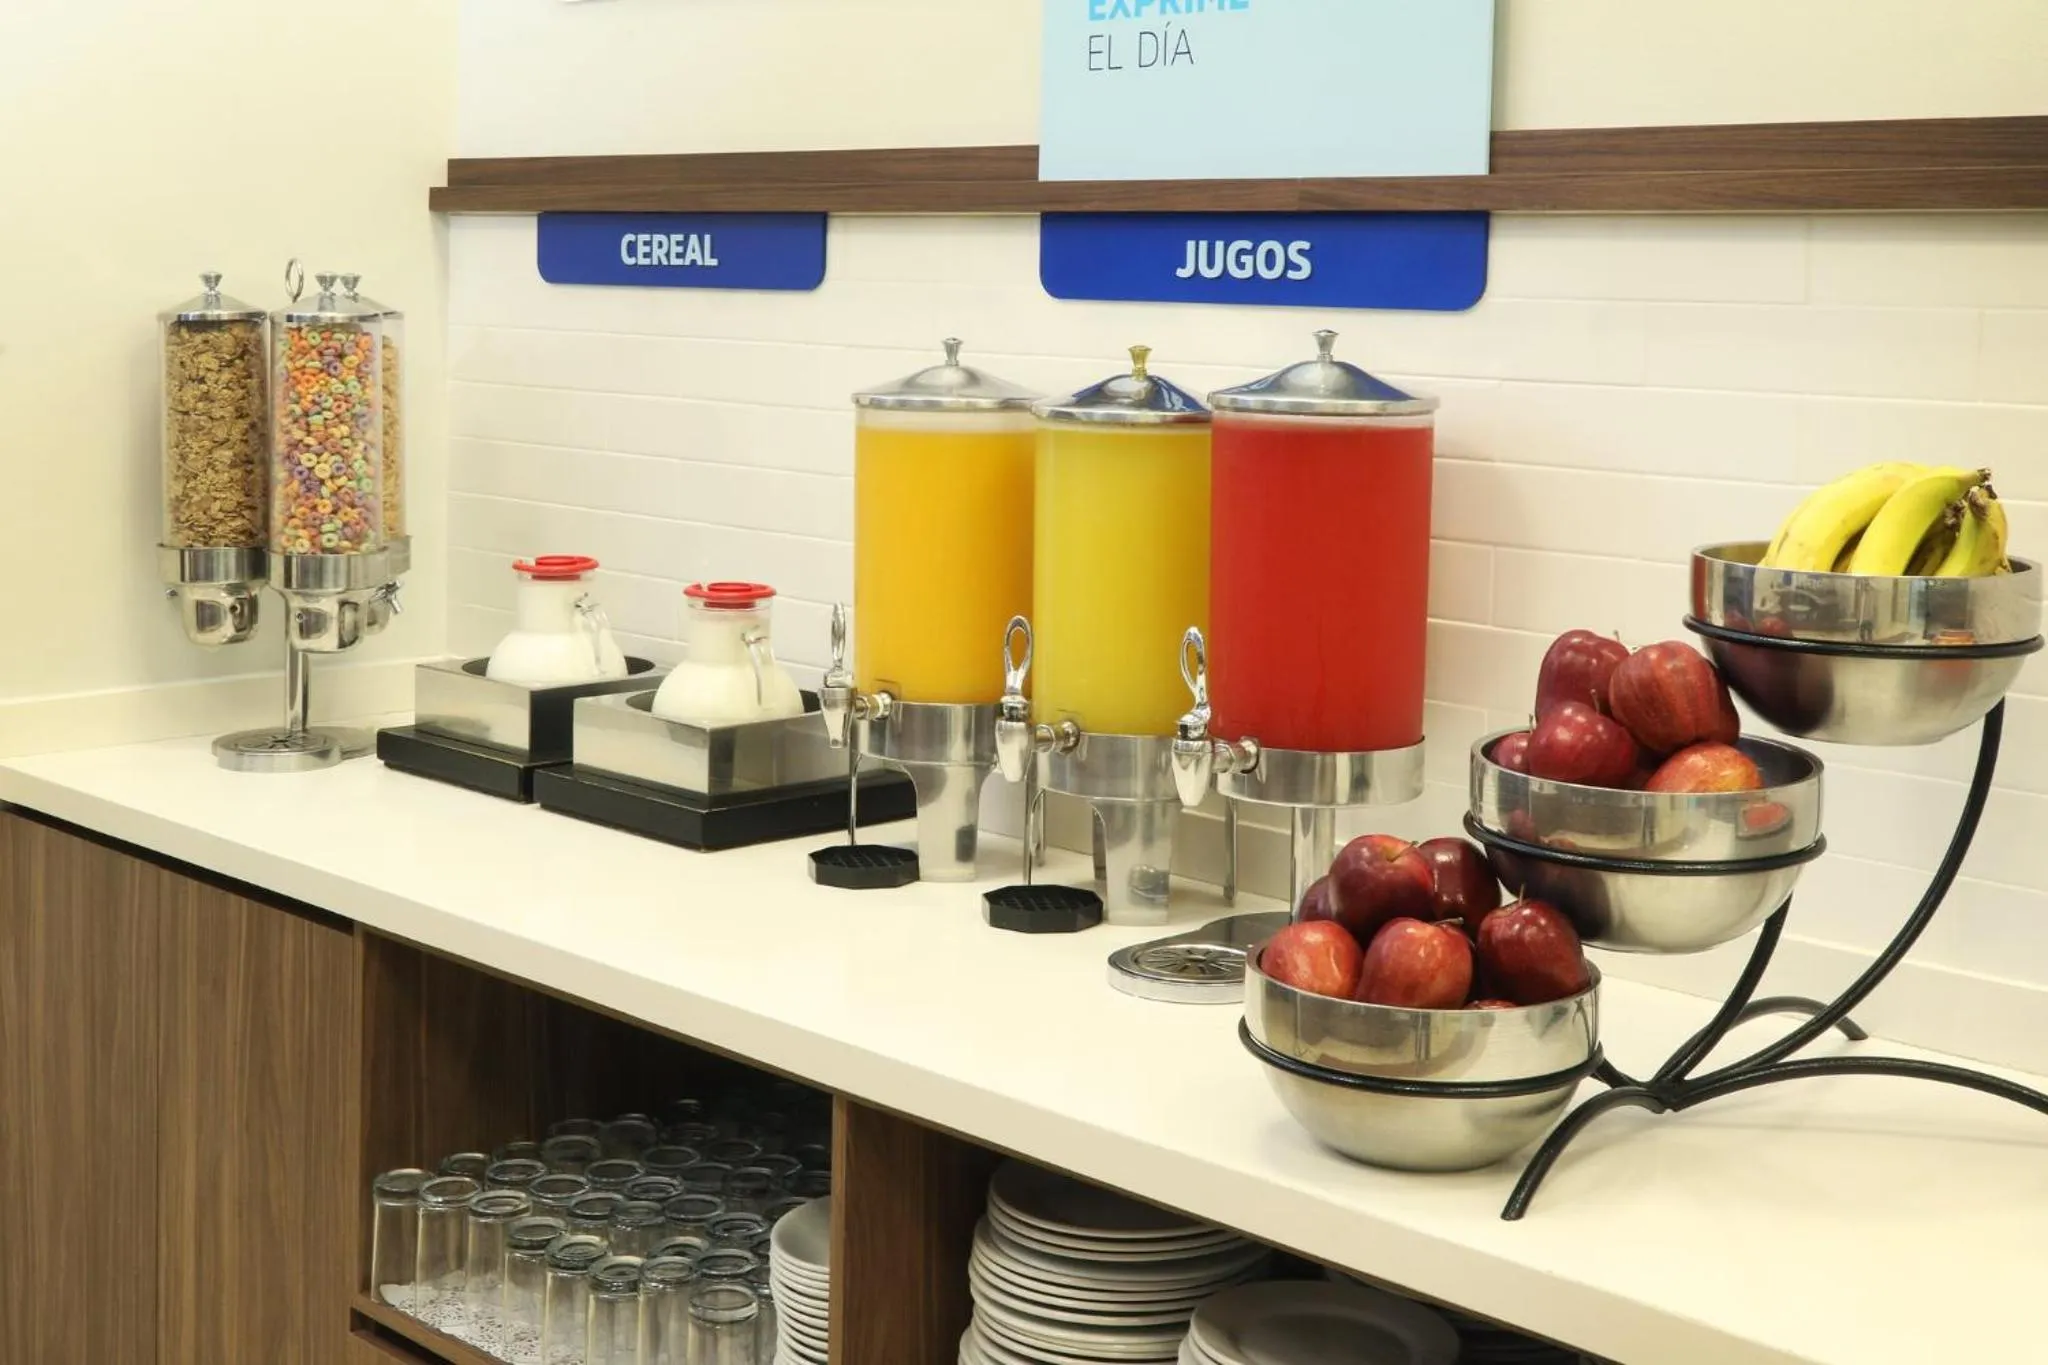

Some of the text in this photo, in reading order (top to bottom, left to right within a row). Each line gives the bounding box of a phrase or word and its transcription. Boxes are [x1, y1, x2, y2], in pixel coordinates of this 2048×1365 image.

[1088, 21, 1194, 71] EL DÍA
[620, 233, 719, 266] CEREAL
[1175, 239, 1312, 280] JUGOS
